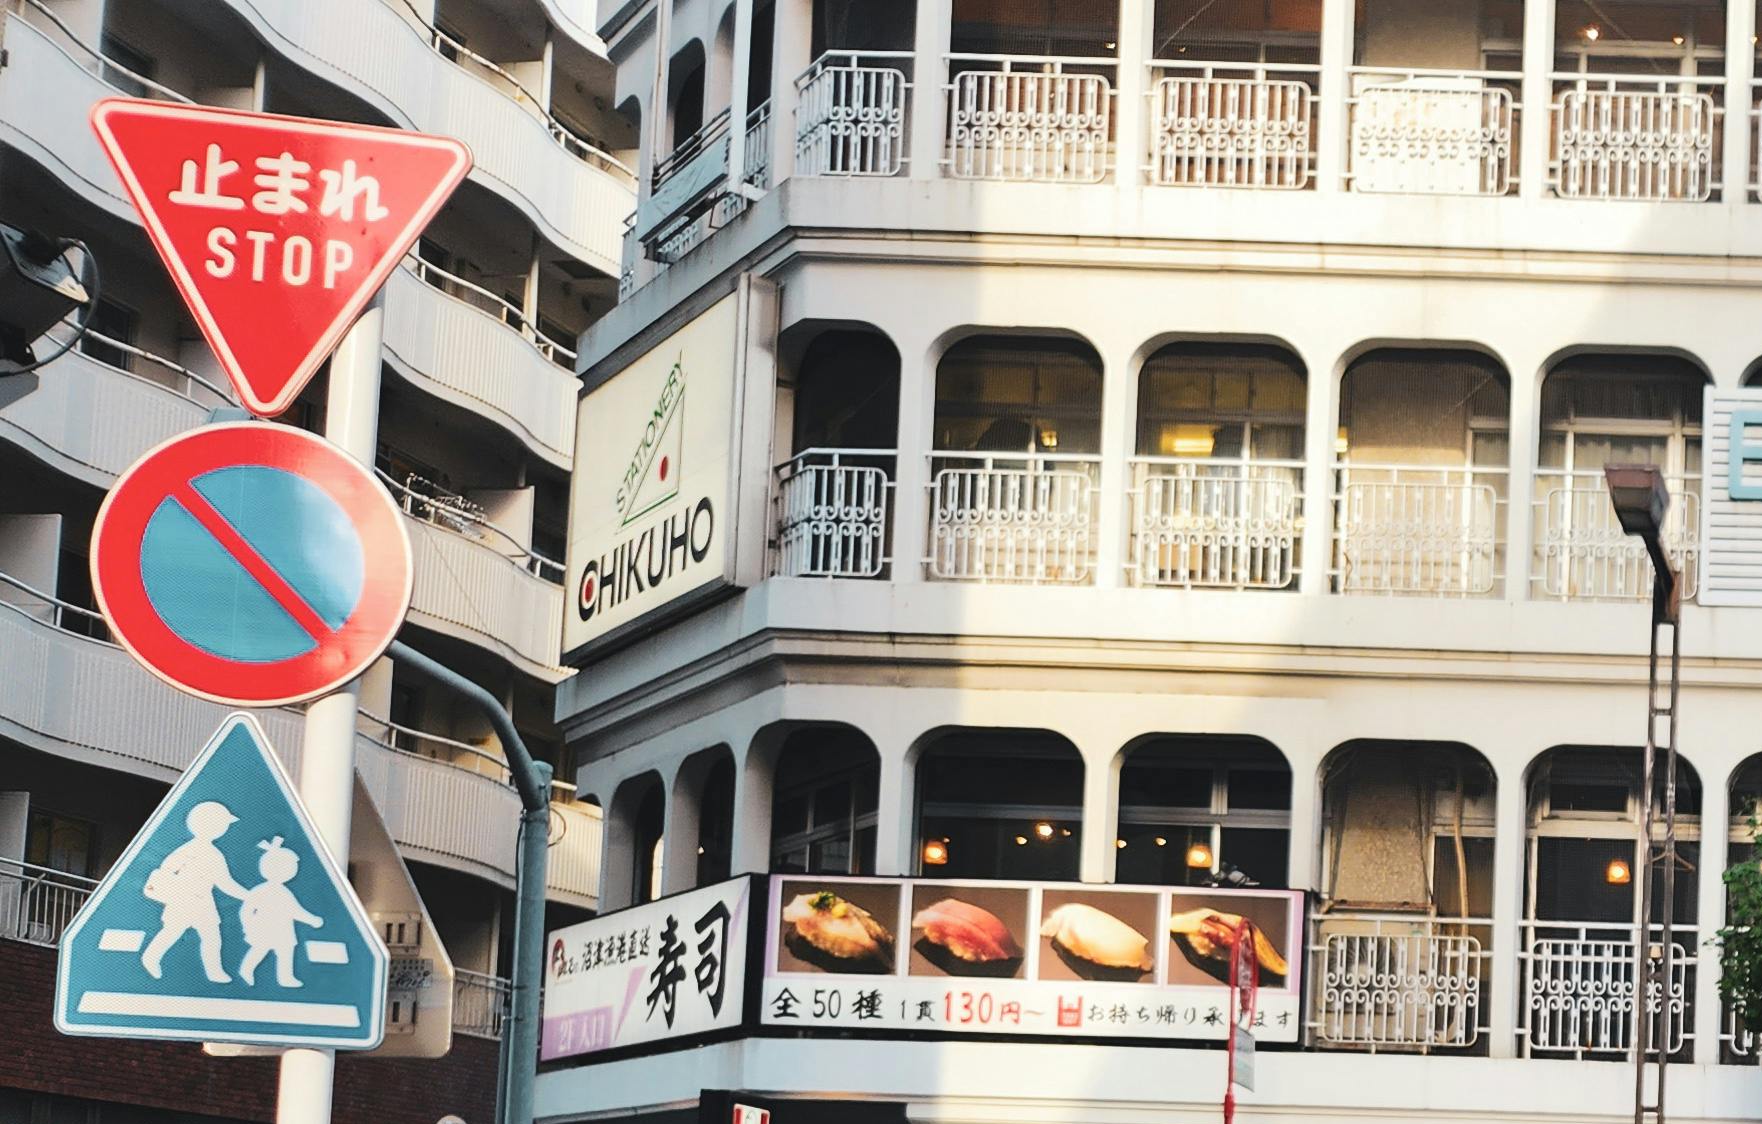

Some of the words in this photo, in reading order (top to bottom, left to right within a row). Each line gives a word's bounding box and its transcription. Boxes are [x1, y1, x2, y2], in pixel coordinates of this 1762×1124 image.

[169, 143, 389, 223] 止まれ
[205, 226, 355, 290] STOP
[615, 349, 687, 513] STATIONERY
[578, 496, 714, 622] CHIKUHO
[645, 899, 732, 1031] 寿司
